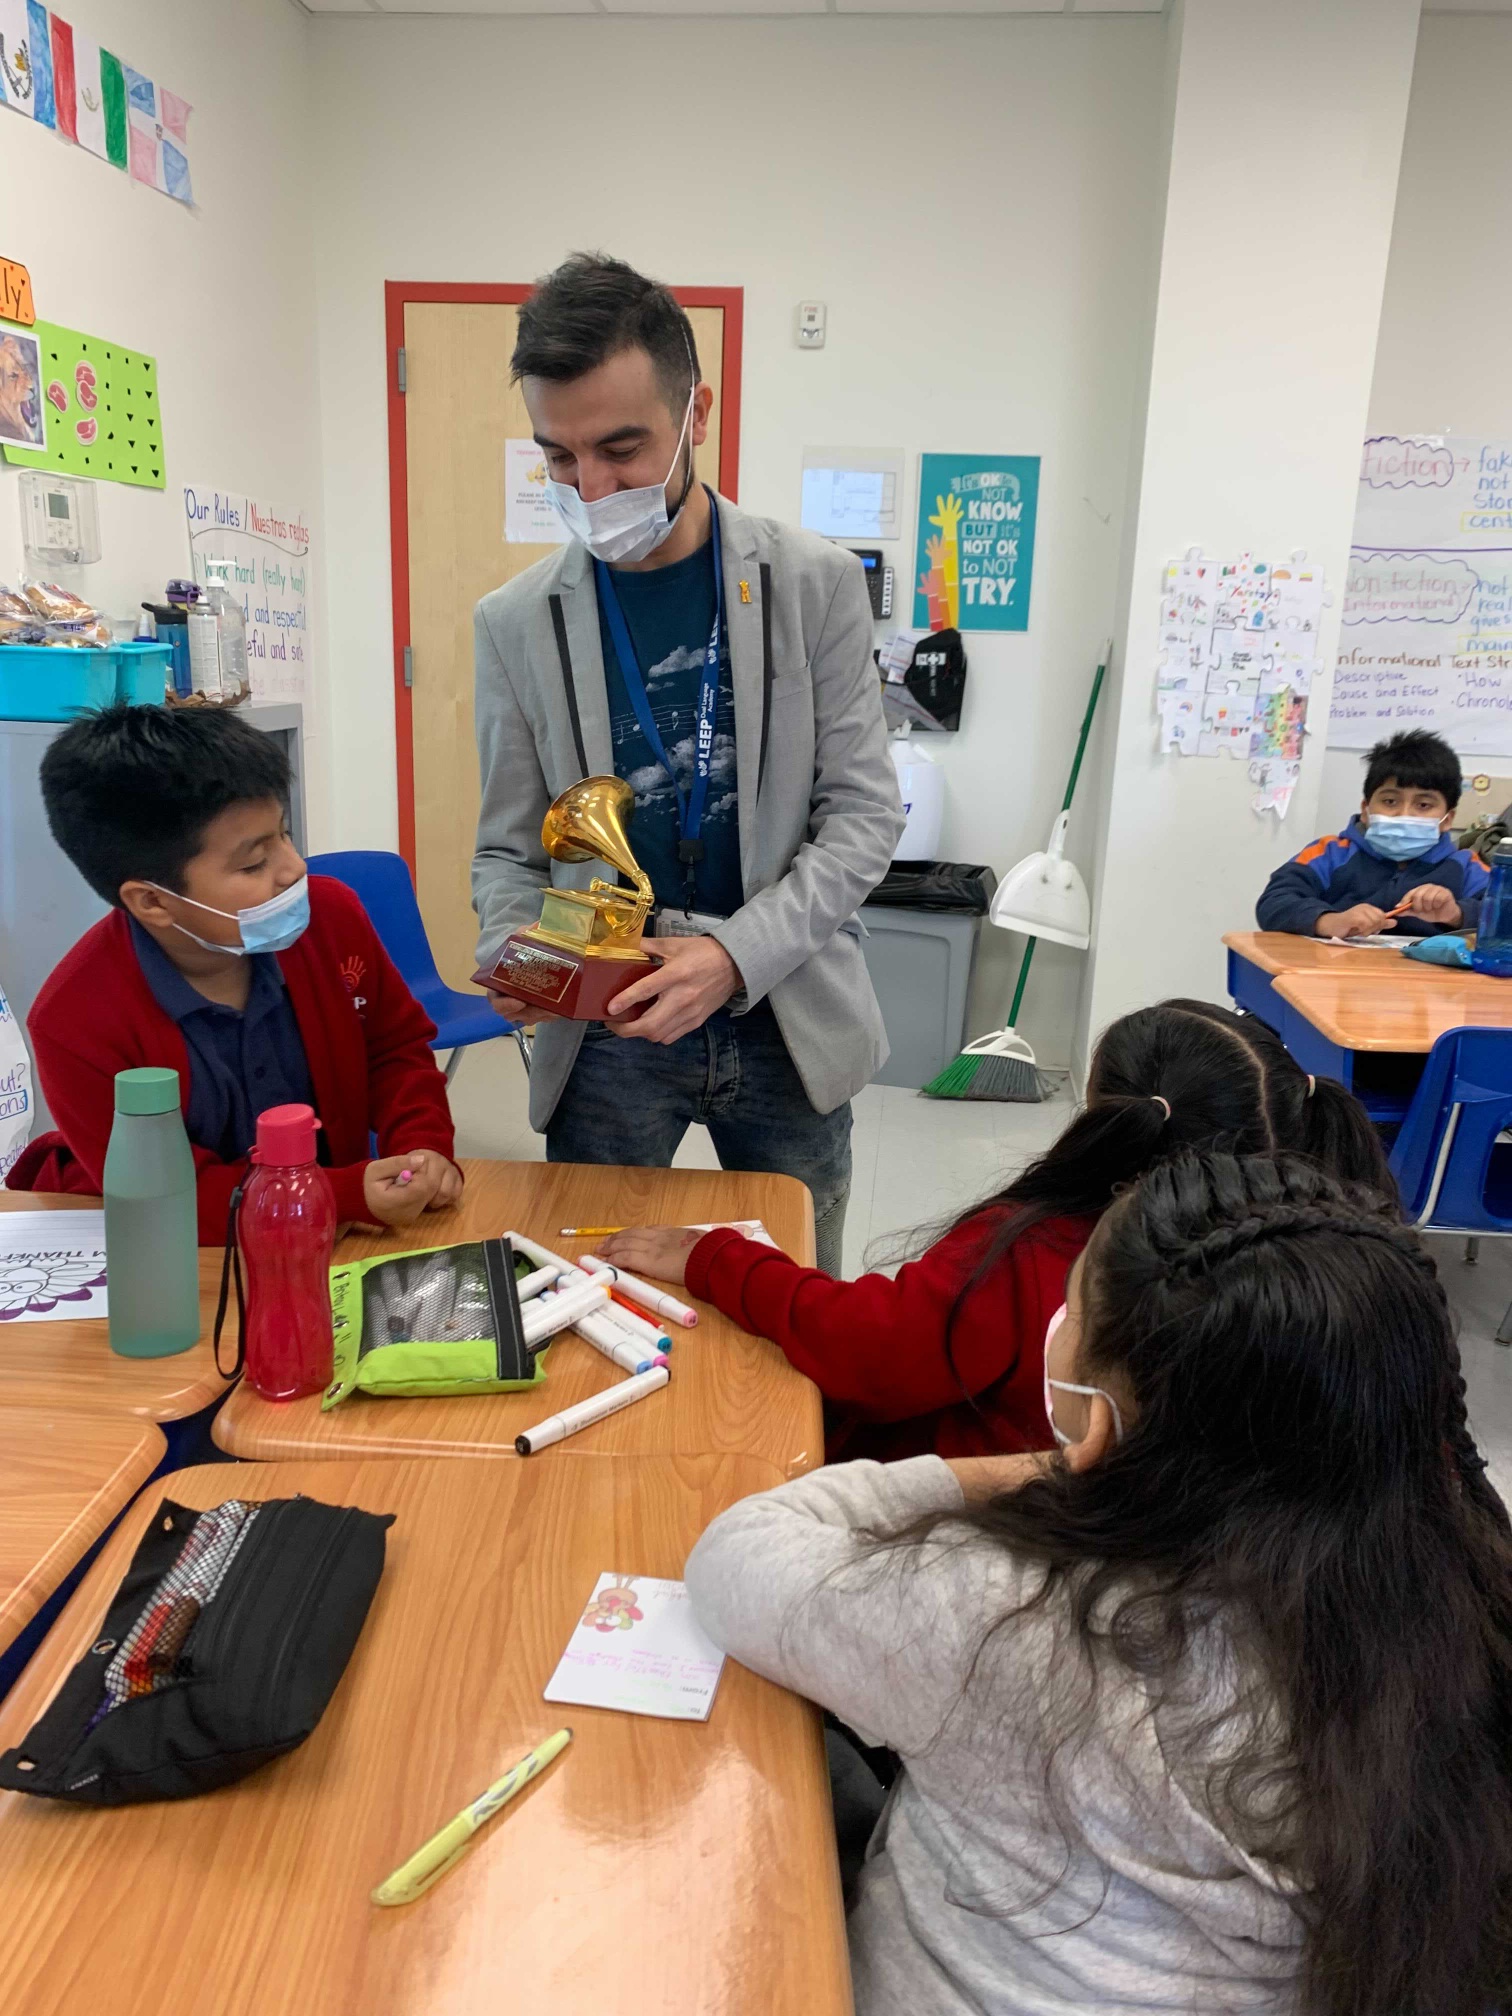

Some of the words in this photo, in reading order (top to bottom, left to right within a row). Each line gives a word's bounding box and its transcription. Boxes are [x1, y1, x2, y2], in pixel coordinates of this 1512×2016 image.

[0, 266, 21, 319] ly
[1478, 445, 1512, 473] fak
[980, 472, 1001, 487] OK
[981, 488, 1008, 500] NOT
[186, 488, 210, 520] Our
[214, 493, 240, 528] Rules
[250, 503, 287, 539] Nuestras
[968, 500, 1023, 522] KNOW,
[965, 523, 994, 537] BUT
[962, 540, 993, 555] NOT
[996, 540, 1019, 556] OK
[962, 558, 979, 574] to
[982, 558, 1018, 576] NOT
[961, 576, 1017, 606] TRY.
[254, 596, 270, 624] and
[270, 631, 287, 661] and
[1337, 646, 1441, 668] nformational
[1449, 654, 1480, 669] Text
[1465, 671, 1502, 688] How
[1375, 688, 1397, 698] and
[698, 719, 713, 759] LEEP
[0, 1062, 26, 1092] ut?
[0, 1095, 26, 1114] ons
[1, 1249, 84, 1259] THANKF
